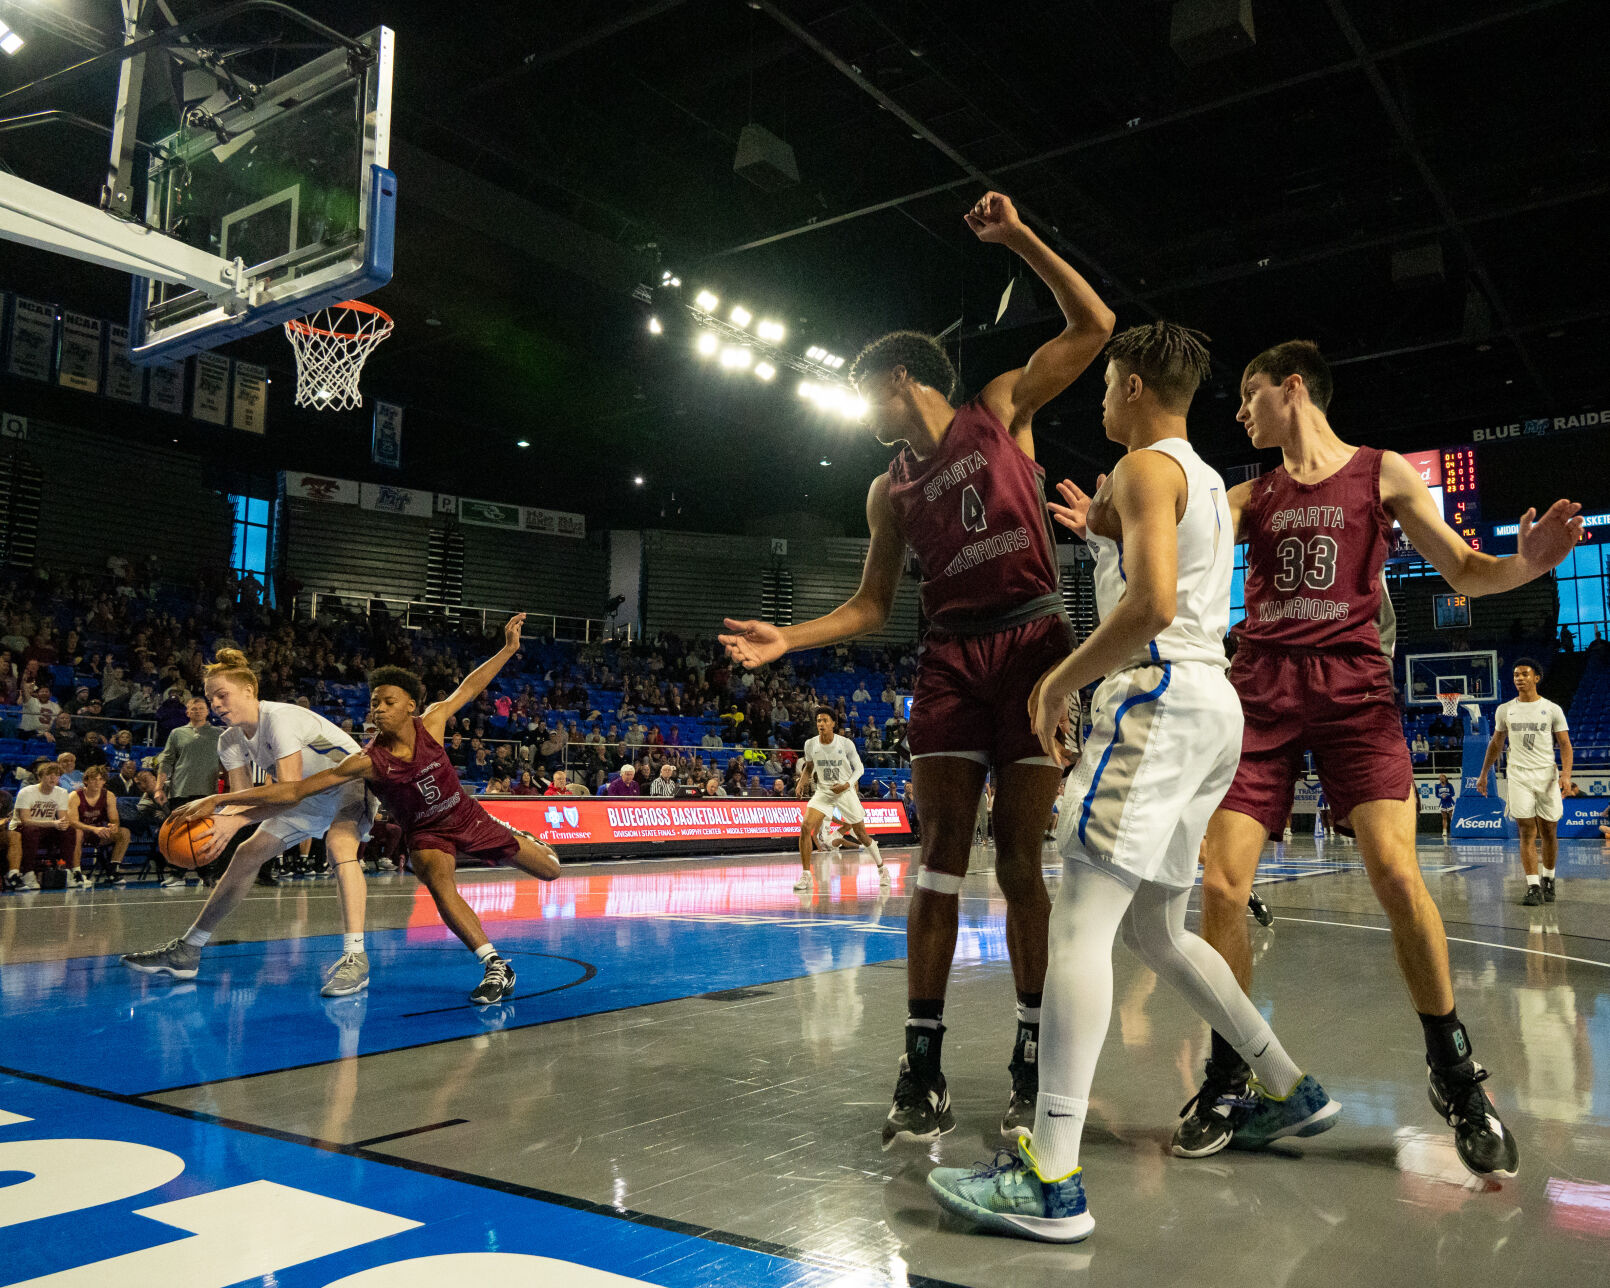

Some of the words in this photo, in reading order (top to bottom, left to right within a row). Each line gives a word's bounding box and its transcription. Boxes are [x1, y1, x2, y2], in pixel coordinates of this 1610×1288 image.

[1472, 424, 1521, 442] BLUE
[924, 451, 988, 502] SPARTA
[962, 484, 988, 532] 4
[1458, 502, 1465, 511] 4
[1271, 506, 1345, 532] SPARTA
[1454, 513, 1462, 524] 5
[1463, 528, 1476, 536] MLK
[944, 527, 1030, 577] WARRIORS
[1472, 539, 1479, 550] 5
[1274, 535, 1338, 591] 33
[1259, 597, 1350, 622] WARRIORS
[416, 774, 441, 805] 5
[607, 807, 671, 827] BLUECROSS
[670, 807, 732, 826] BASKETBALL
[730, 806, 803, 825] CHAMPIONSHIPS
[1455, 817, 1503, 828] Ascend
[540, 830, 549, 840] of
[550, 830, 591, 840] Tennessee
[641, 829, 657, 837] STATE
